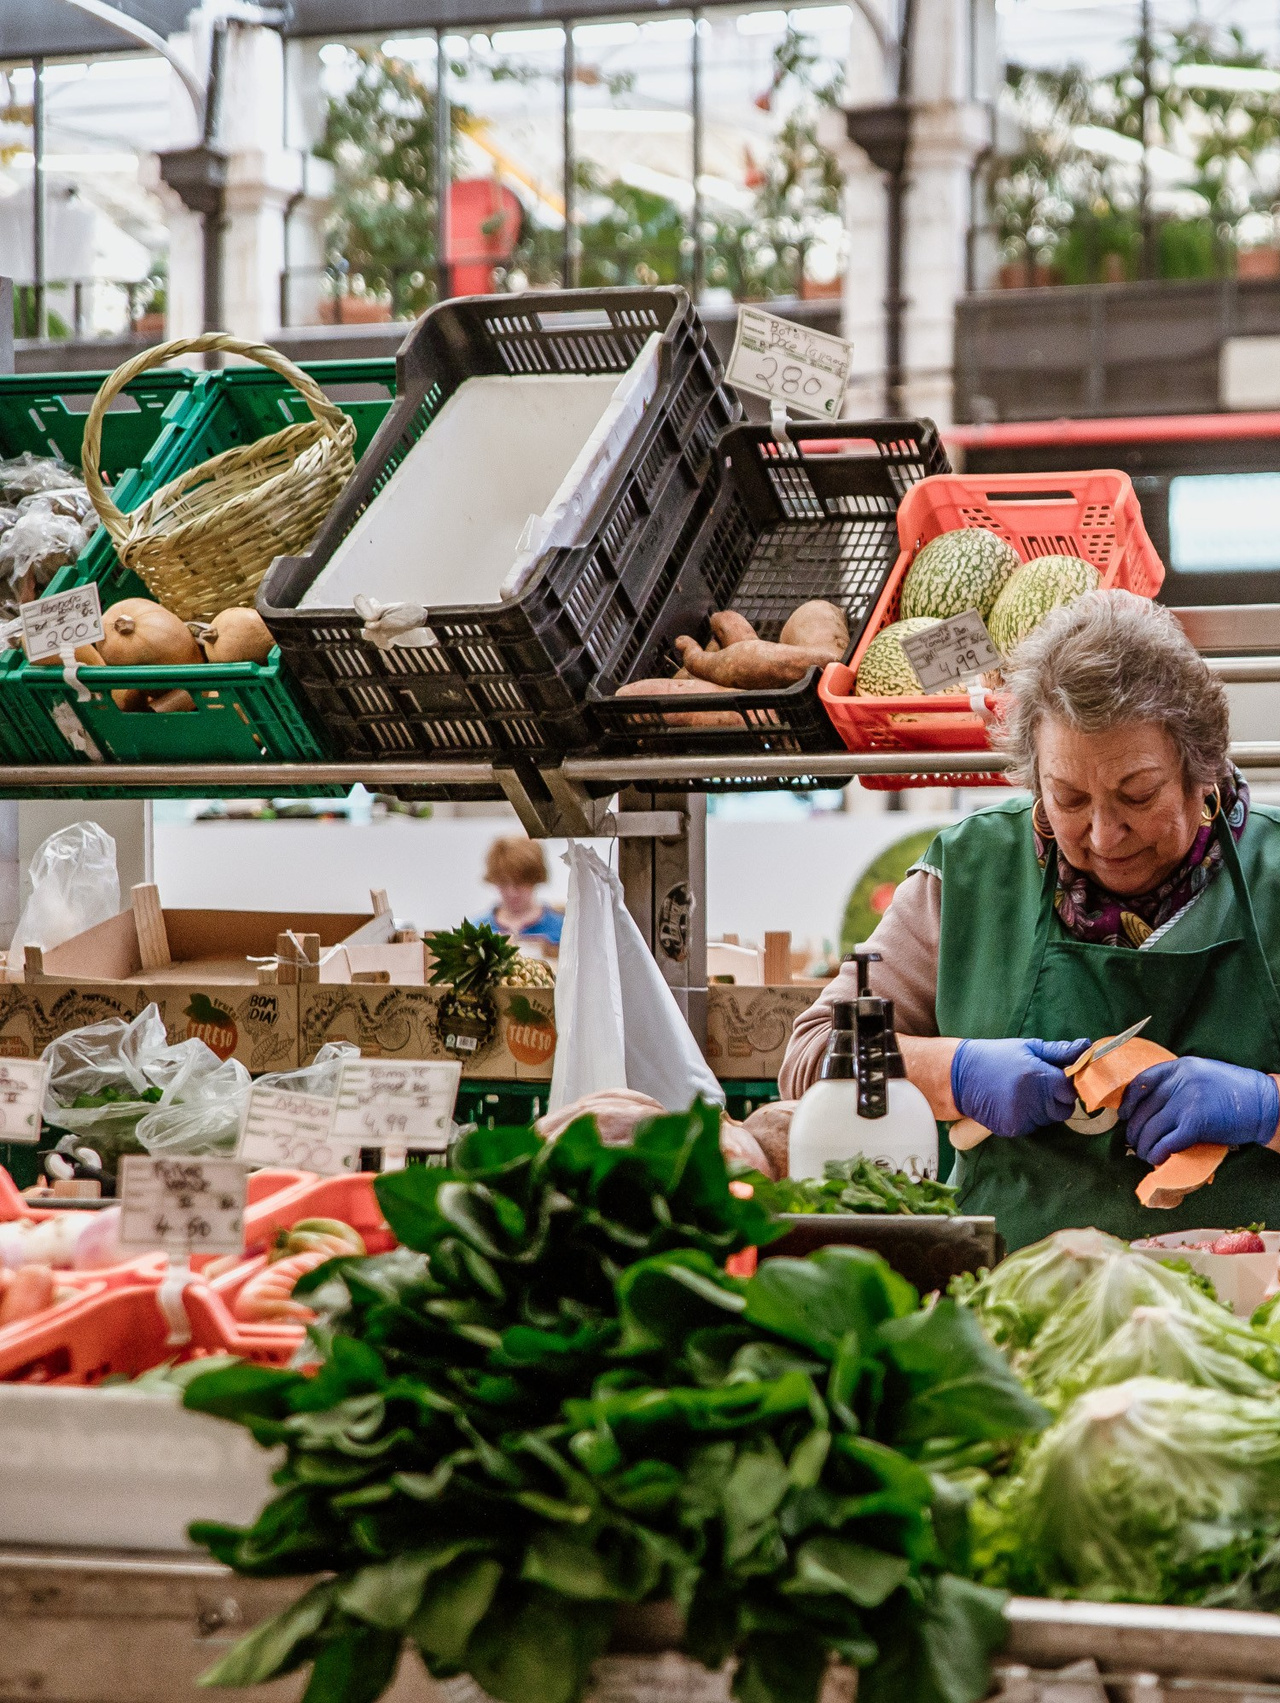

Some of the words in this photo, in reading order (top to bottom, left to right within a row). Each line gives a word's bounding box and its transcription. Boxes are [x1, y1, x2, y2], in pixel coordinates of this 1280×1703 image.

[250, 995, 277, 1011] BOM
[250, 1008, 278, 1027] DIA!
[190, 1023, 233, 1048] TERESO
[509, 1024, 552, 1051] TERESO
